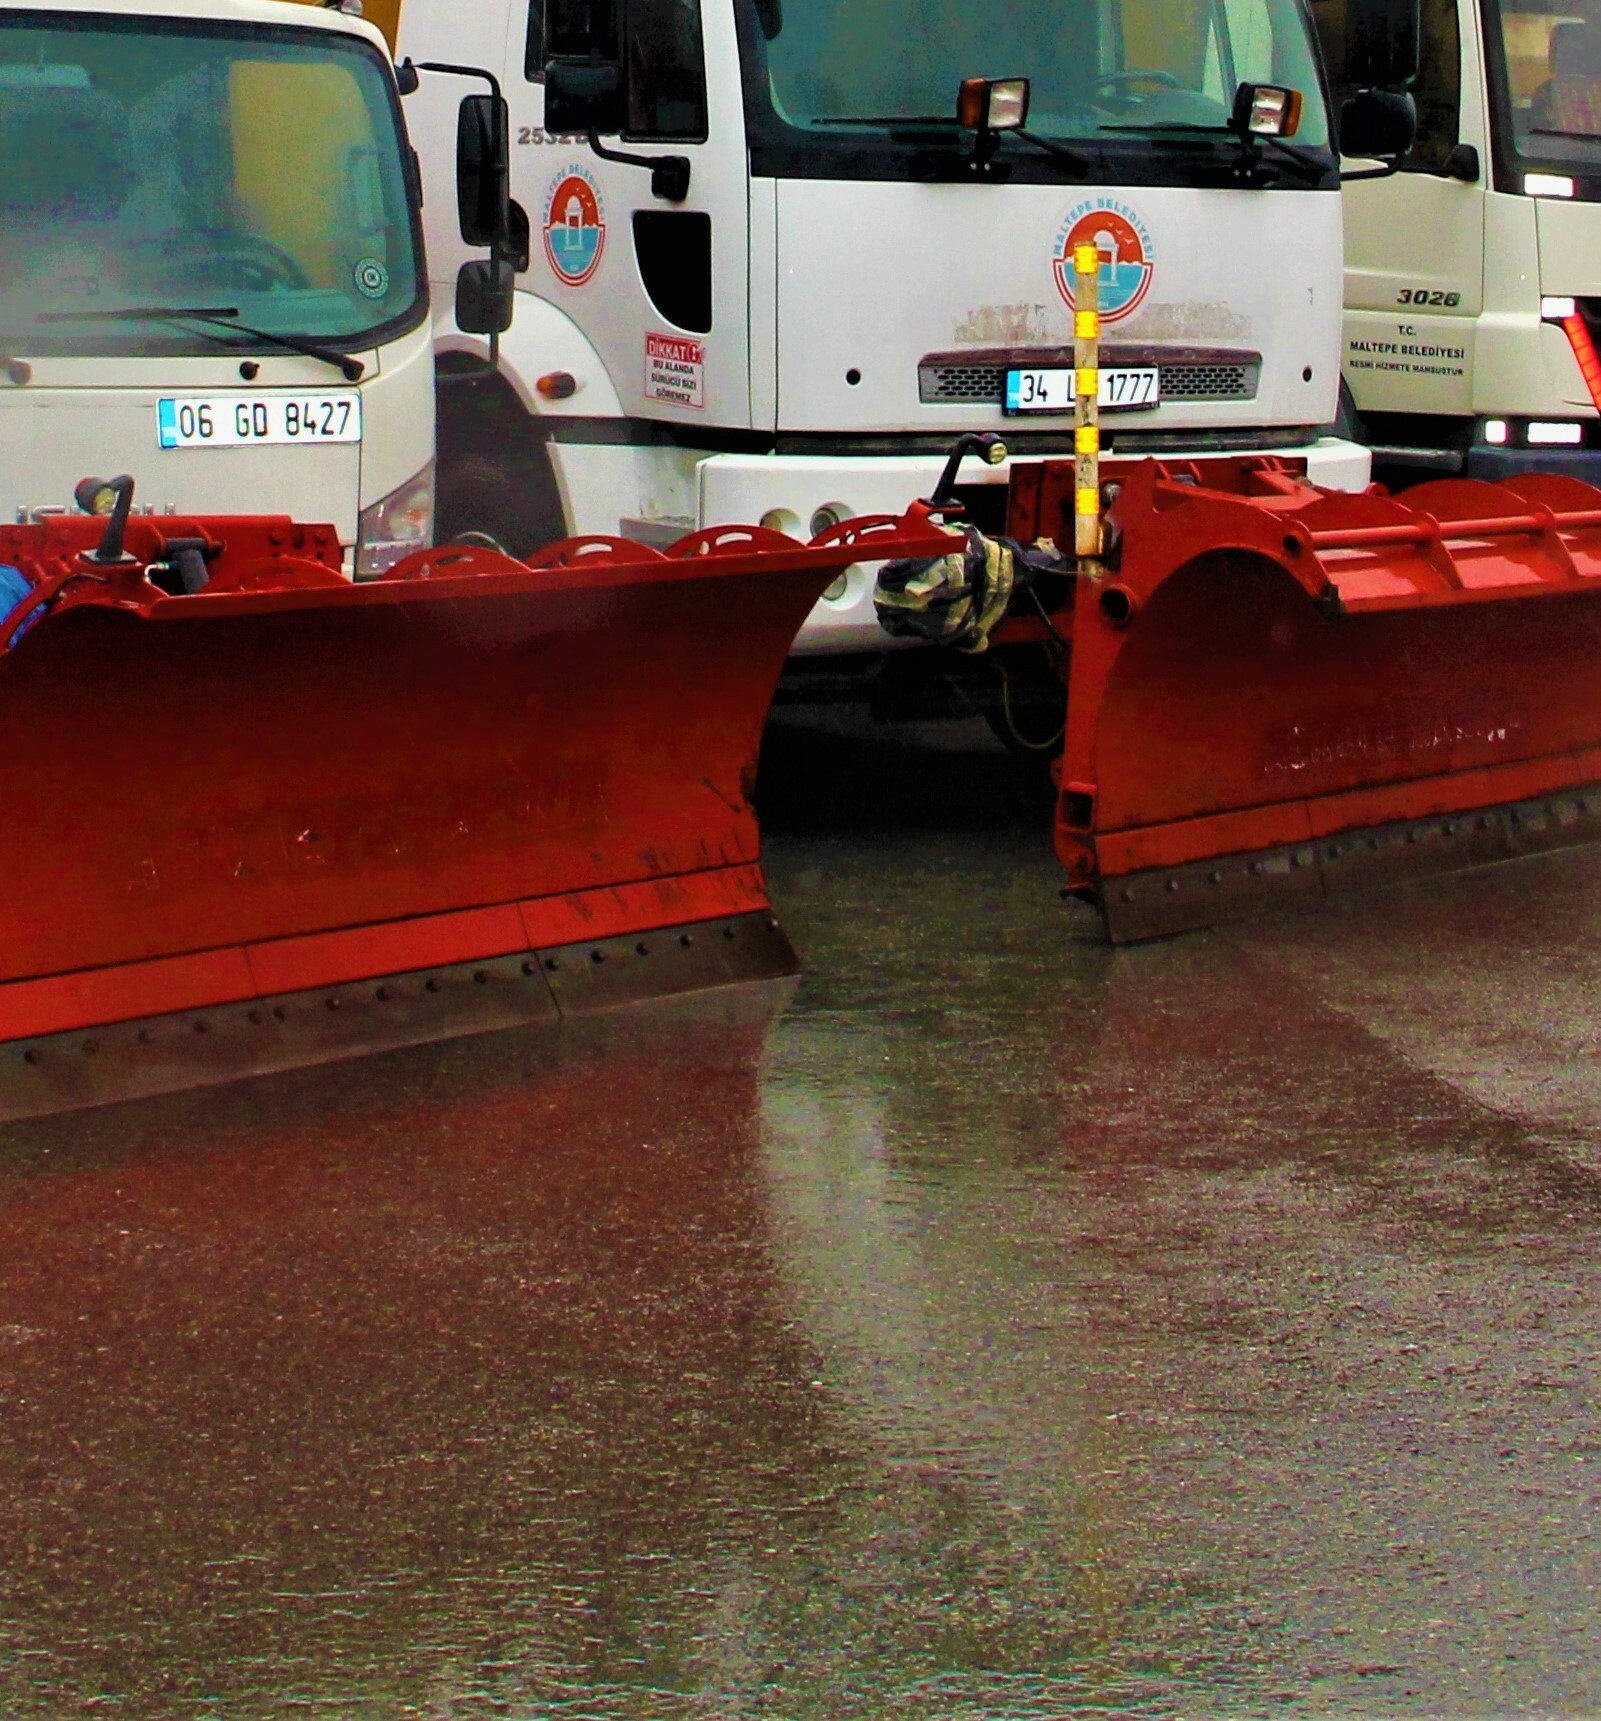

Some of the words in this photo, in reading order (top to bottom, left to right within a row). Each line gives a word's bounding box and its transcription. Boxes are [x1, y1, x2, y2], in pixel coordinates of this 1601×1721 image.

[1053, 200, 1092, 256] MALTEPE
[1396, 288, 1462, 307] 3026
[1398, 325, 1417, 336] T.C.
[648, 338, 687, 361] DİKKAT
[1350, 340, 1398, 354] MALTEPE
[1401, 344, 1464, 359] BELEDİYESİ
[653, 359, 664, 370] BU
[665, 361, 694, 375] ALANDA
[1022, 374, 1048, 403] 34
[1106, 373, 1155, 402] 1777
[179, 404, 214, 439] 06
[235, 403, 268, 437] GD
[285, 401, 352, 437] 8427
